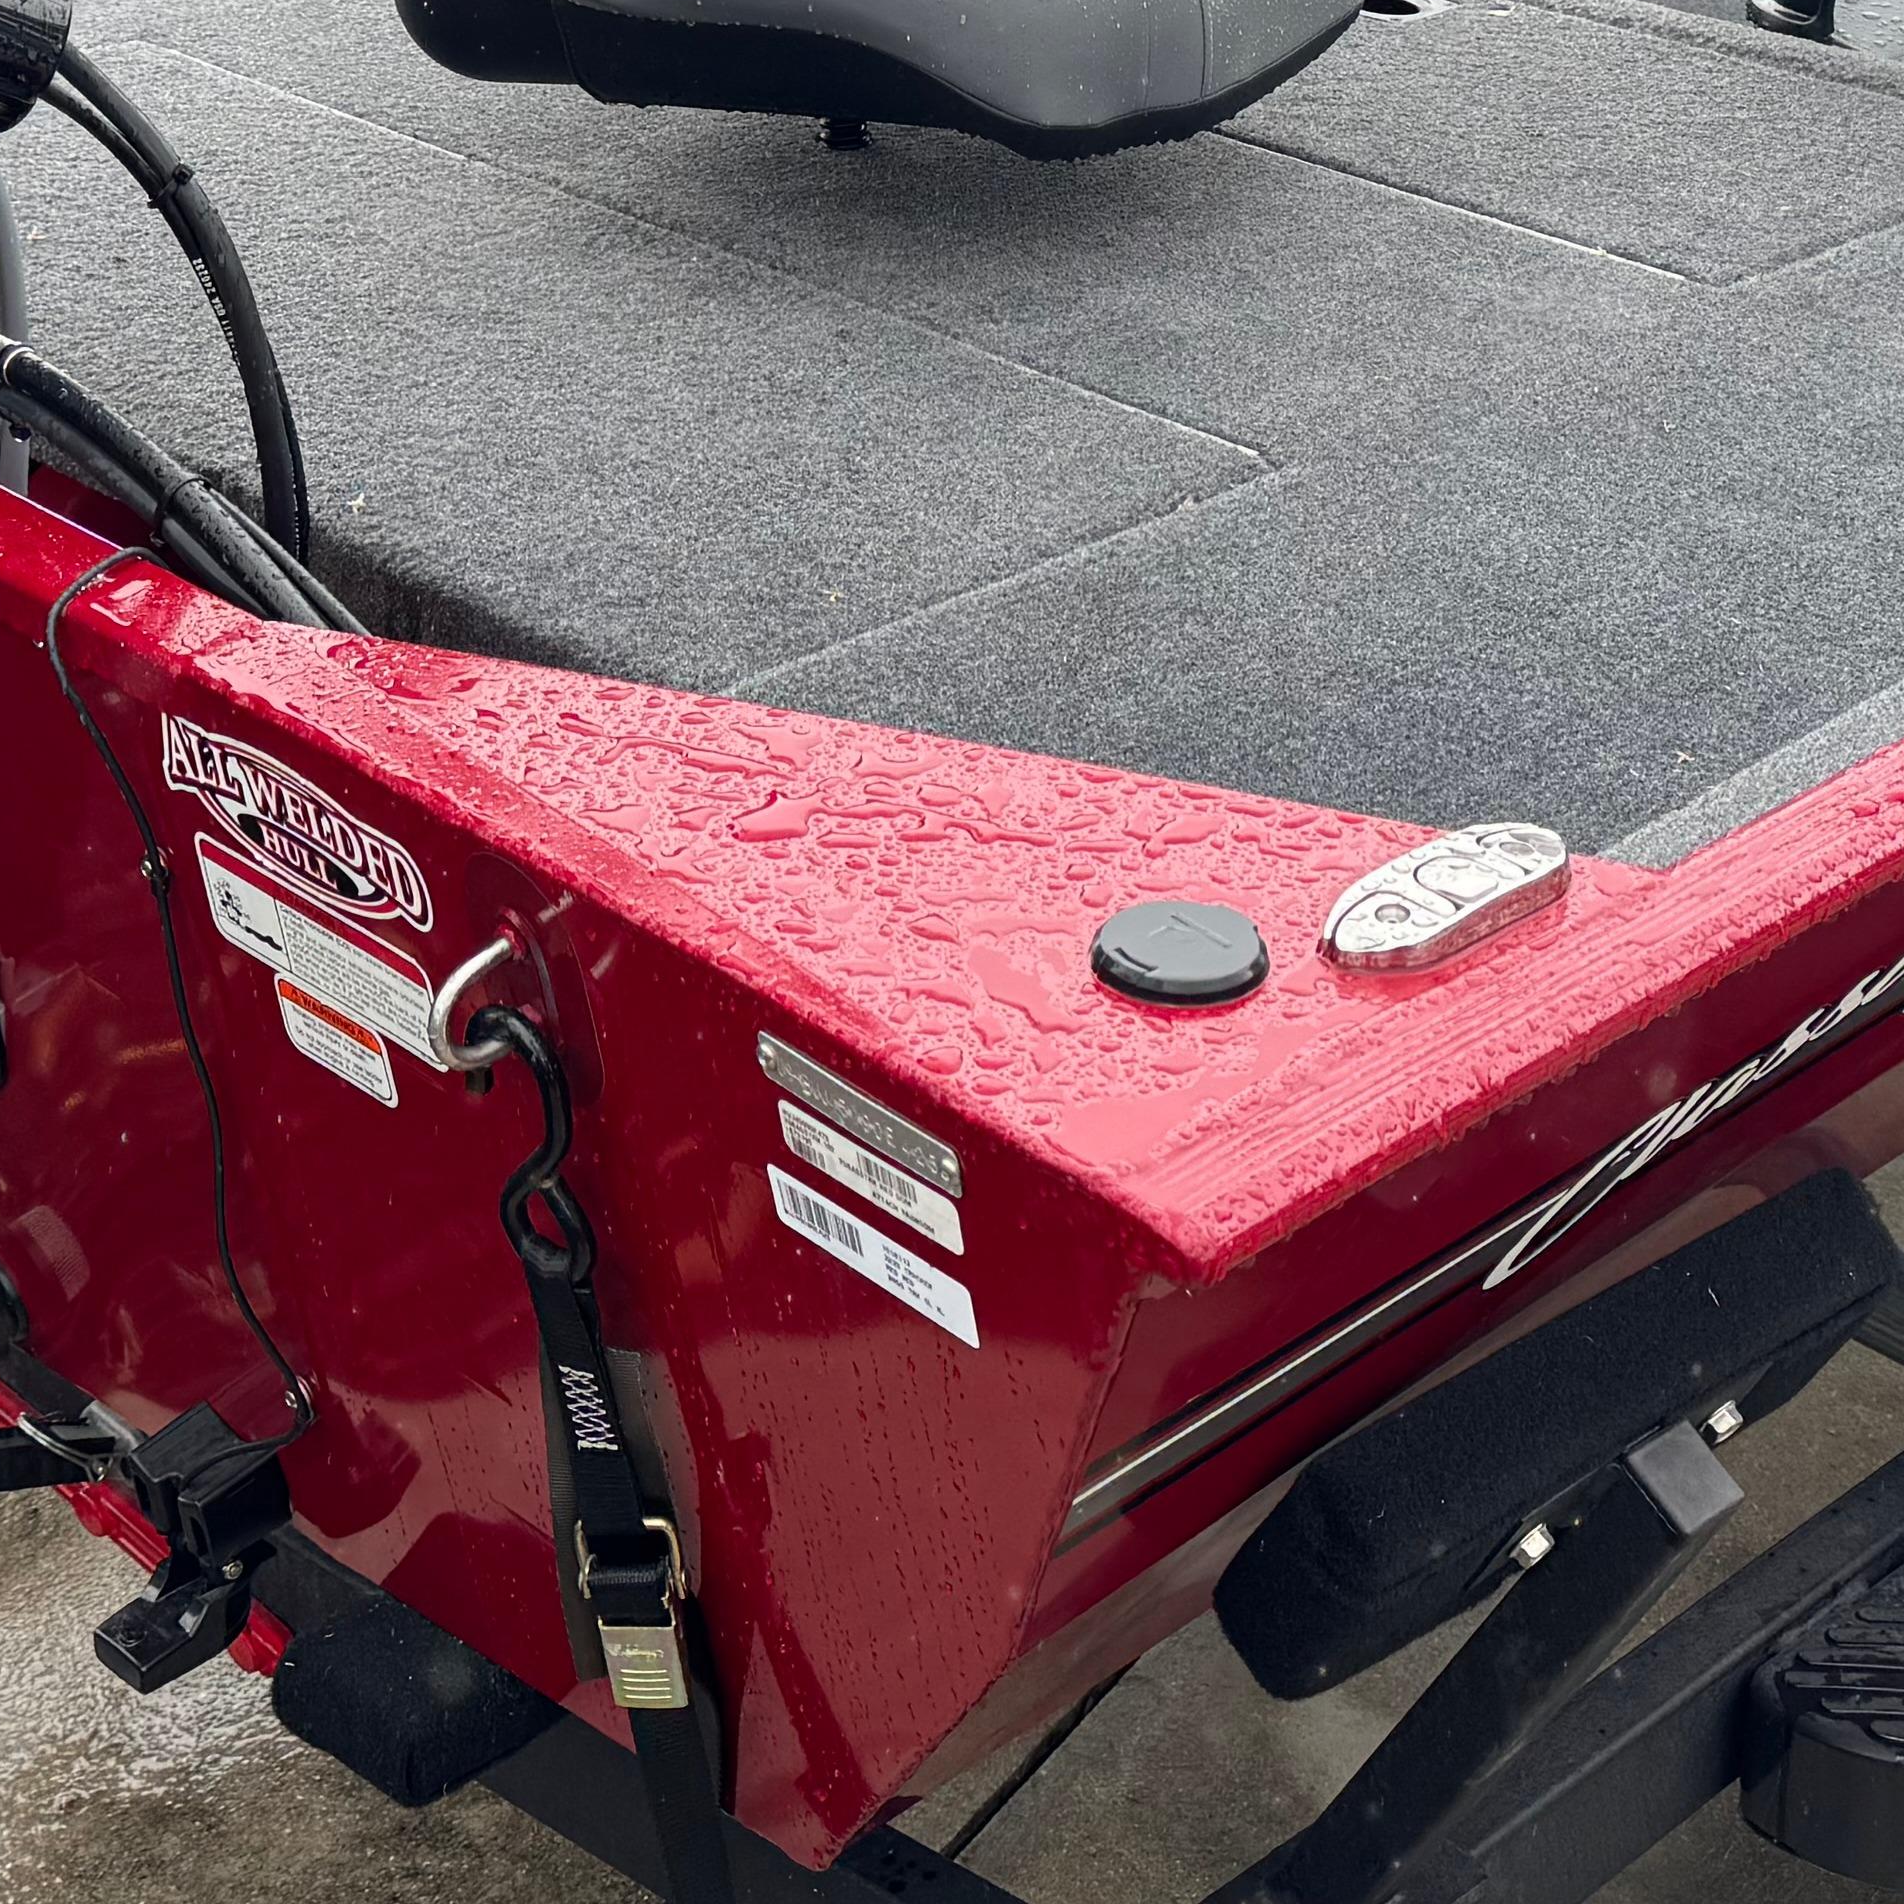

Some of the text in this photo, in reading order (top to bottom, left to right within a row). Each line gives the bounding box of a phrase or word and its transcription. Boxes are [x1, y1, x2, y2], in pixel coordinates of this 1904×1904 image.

[170, 717, 242, 797] ALL
[244, 761, 422, 917] WELDED
[261, 825, 338, 895] HULL
